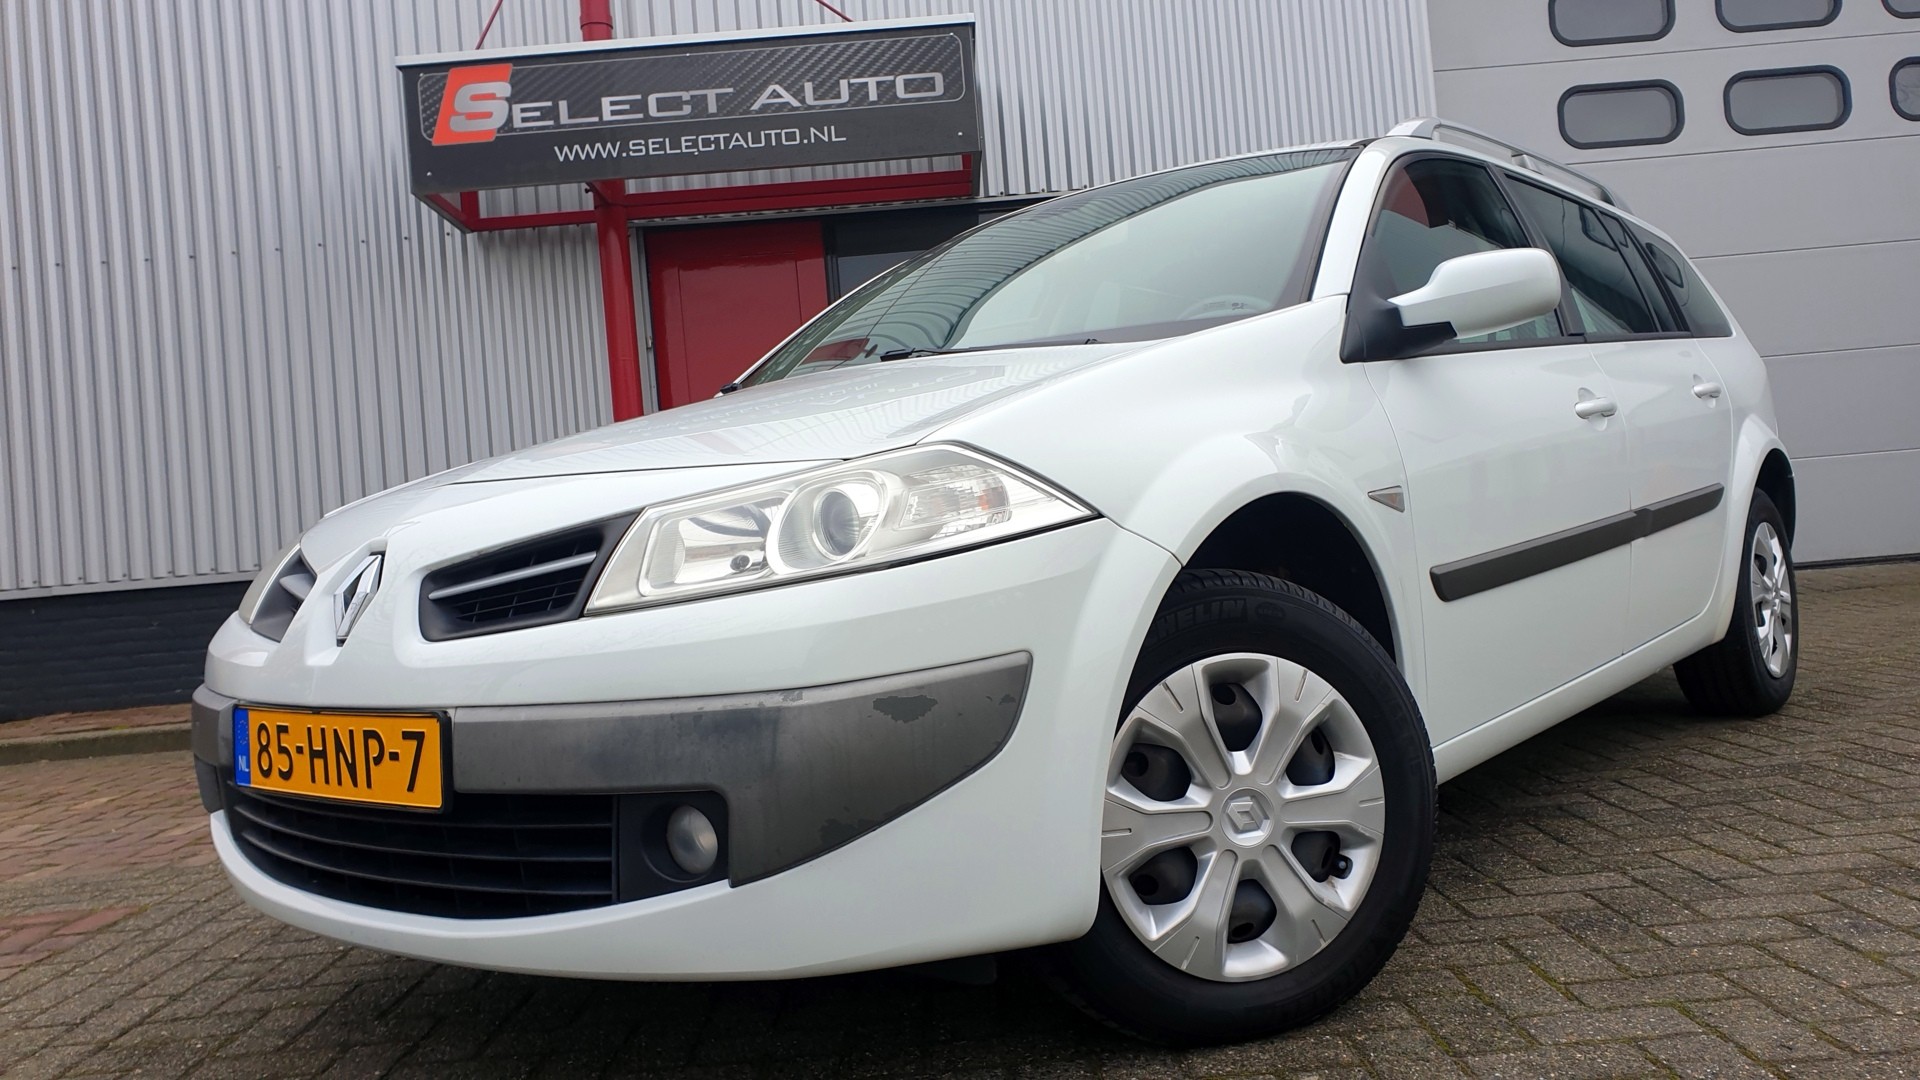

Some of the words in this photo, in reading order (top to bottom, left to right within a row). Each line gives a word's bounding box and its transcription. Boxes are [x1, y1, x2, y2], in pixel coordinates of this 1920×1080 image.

[450, 81, 734, 132] SELECT
[750, 72, 945, 111] AUTO
[554, 125, 846, 162] WWW.SELECTAUTO.NL
[238, 755, 250, 772] NL
[256, 722, 426, 793] 85-HNP-7
